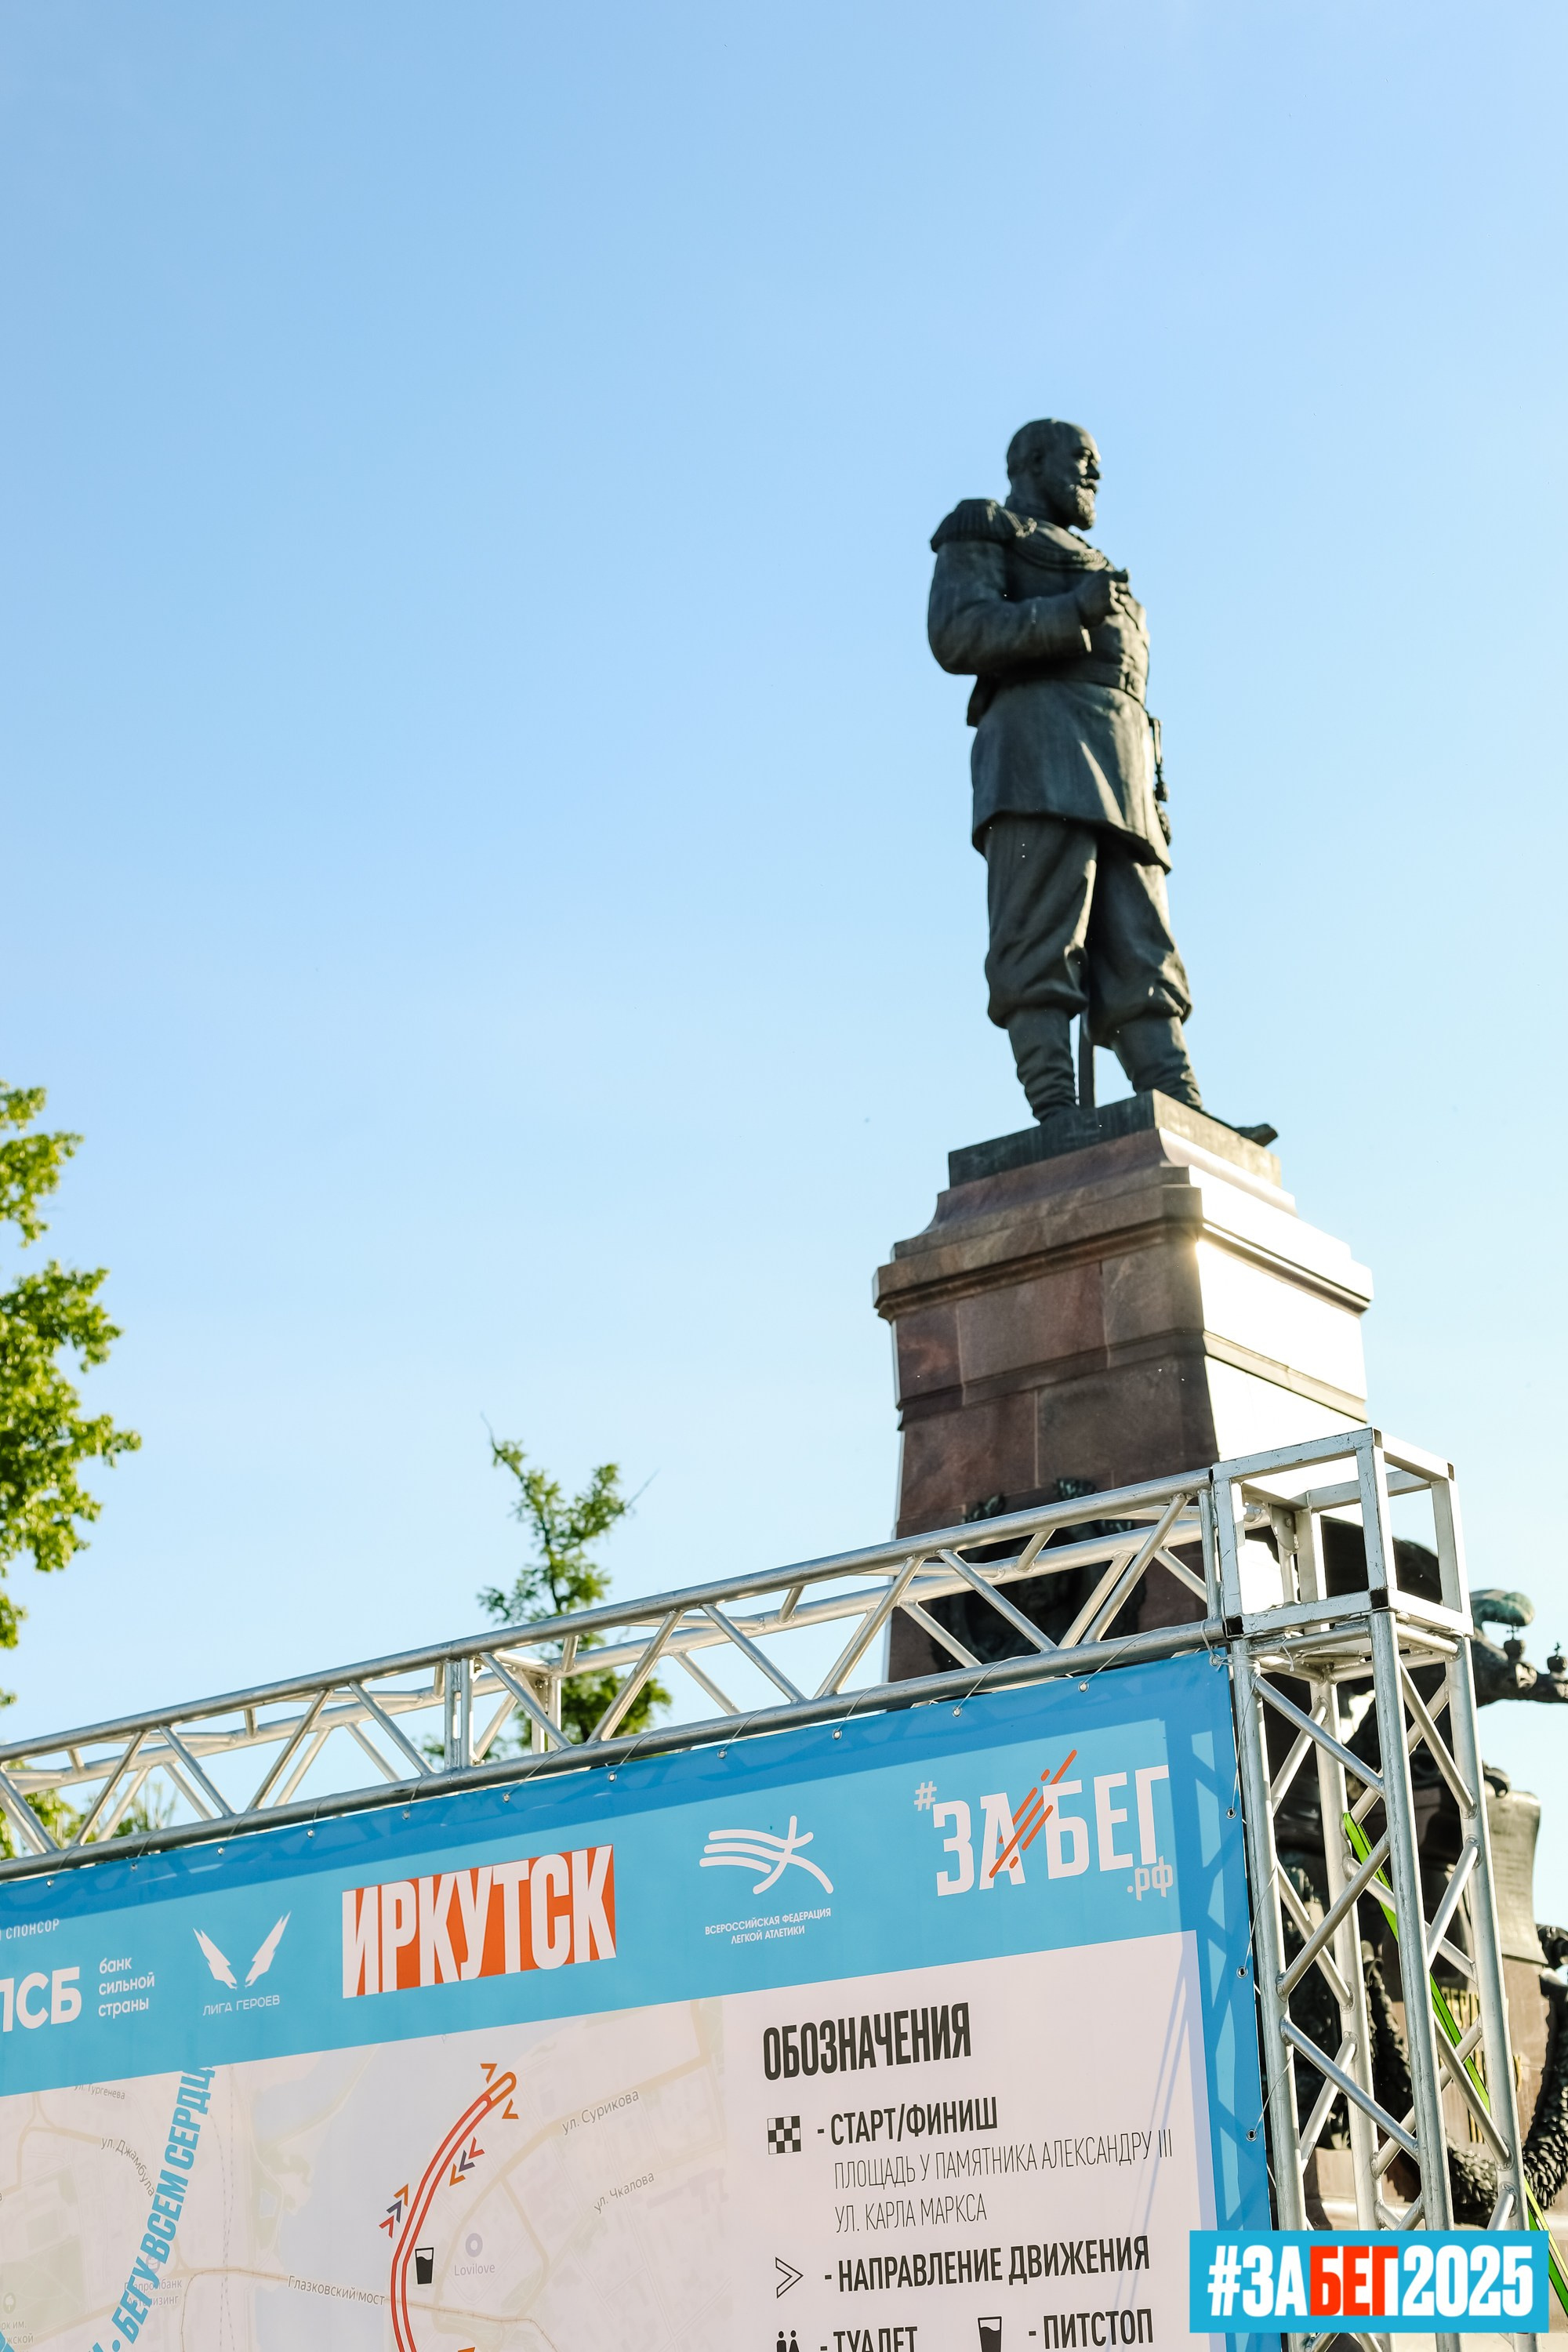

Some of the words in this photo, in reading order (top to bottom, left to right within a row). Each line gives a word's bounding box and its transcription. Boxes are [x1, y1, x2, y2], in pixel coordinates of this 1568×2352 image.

[5, 1918, 60, 1940] СПОНСОР
[342, 1844, 617, 1998] ИРКУТСК
[705, 1915, 779, 1935] ВСЕРОССИЙСКАЯ
[782, 1907, 831, 1924] ФЕДЕРАЦИЯ
[731, 1929, 763, 1944] ЛЕГКОЙ
[764, 1925, 805, 1940] АТЛЕТИКИ
[99, 1957, 132, 1974] банк
[99, 1972, 155, 1995] сильной
[98, 1998, 149, 2019] страны
[202, 2002, 233, 2016] ЛИГА
[236, 1994, 281, 2011] ГЕРОЕВ
[763, 2002, 971, 2081] ОБОЗНАЧЕНИЯ
[562, 2117, 580, 2135] ул.
[581, 2089, 640, 2125] Сурикова
[831, 2096, 997, 2146] СТАРТ/ФИНИШ
[101, 2136, 115, 2150] ул.
[115, 2139, 154, 2197] Джамбула
[834, 2156, 916, 2190] ПЛОЩАДЬ
[920, 2154, 931, 2181] У
[936, 2143, 1038, 2180] ПАМЯТНИКА
[1042, 2131, 1152, 2170] АЛЕКСАНДРУ
[1158, 2129, 1173, 2158] III
[593, 2194, 609, 2214] ул.
[609, 2171, 655, 2199] Чкалова
[834, 2204, 860, 2234] УЛ.
[866, 2200, 916, 2230] КАРЛА
[920, 2193, 987, 2226] МАРКСА
[111, 2256, 160, 2344] БЕГУ
[140, 2169, 189, 2264] ВСЕМ
[454, 2263, 495, 2276] Lovilove
[838, 2247, 1004, 2292] НАПРАВЛЕНИЕ
[1008, 2235, 1150, 2285] ДВИЖЕНИЯ
[288, 2275, 356, 2299] Глазковский
[358, 2290, 385, 2306] мост
[13, 2321, 27, 2329] им.
[1043, 2308, 1153, 2349] ПИТСТОП
